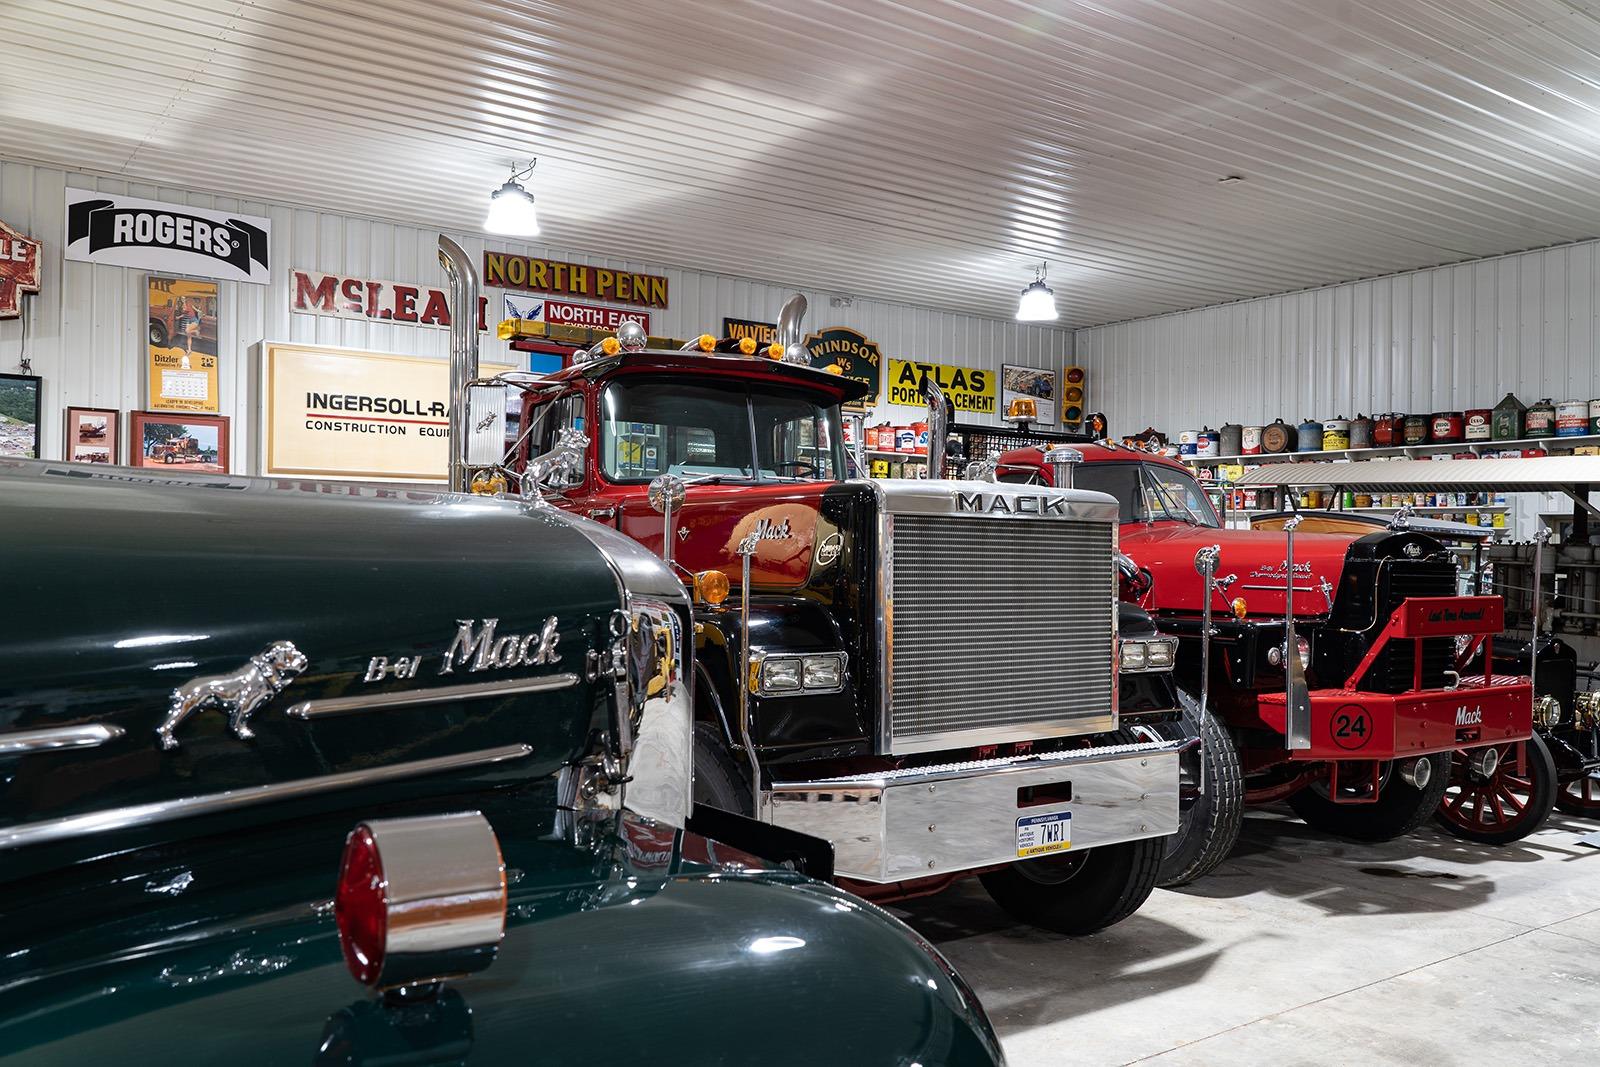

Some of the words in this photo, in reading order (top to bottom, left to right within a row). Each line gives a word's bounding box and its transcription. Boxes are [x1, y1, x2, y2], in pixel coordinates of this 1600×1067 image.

[487, 253, 588, 295] NORTH
[596, 269, 668, 306] PENN
[549, 304, 604, 324] NORTH
[608, 312, 646, 327] EAST
[154, 354, 178, 363] Ditzler
[810, 340, 879, 367] WINDSOR
[898, 362, 985, 393] ATLAS
[954, 392, 995, 411] CEMENT
[305, 420, 406, 435] CONSTRUCTION
[951, 490, 1067, 516] MACK
[754, 518, 792, 541] Mack
[363, 655, 422, 684] B-61
[438, 616, 563, 675] Mack
[1335, 715, 1366, 737] 24
[1455, 705, 1482, 726] Mack
[1040, 822, 1065, 845] 7WR1
